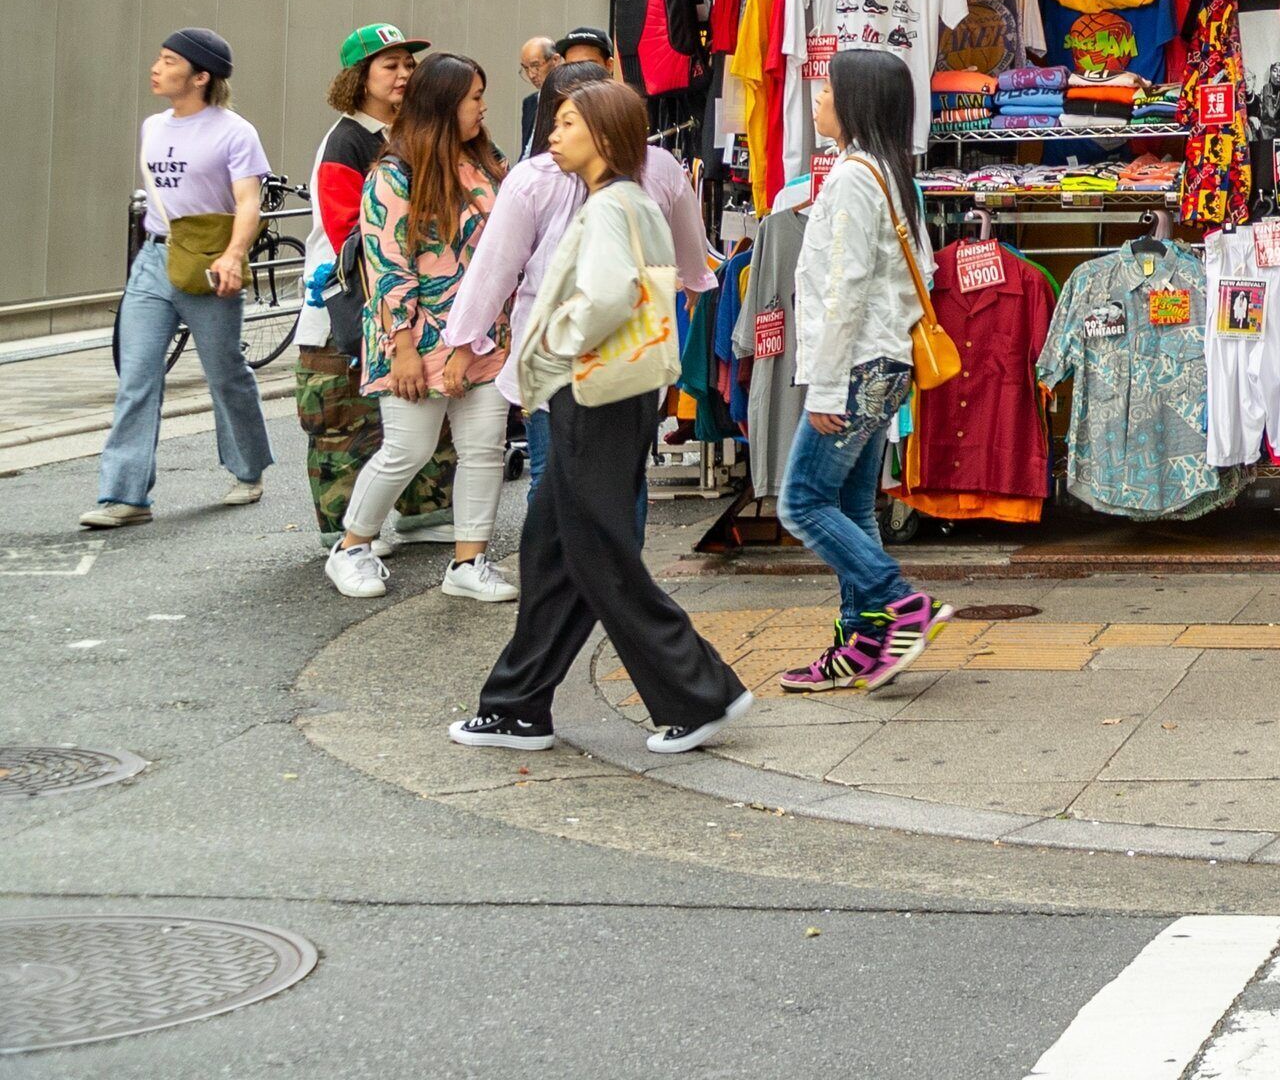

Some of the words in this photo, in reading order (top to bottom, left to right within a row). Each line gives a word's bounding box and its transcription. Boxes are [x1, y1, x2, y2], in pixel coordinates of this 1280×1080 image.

[1207, 93, 1225, 104] 本日
[1207, 103, 1225, 114] 入荷
[168, 147, 173, 157] I
[147, 161, 187, 173] MUST
[155, 176, 182, 188] SAY
[957, 242, 996, 258] FINISH!!
[963, 266, 999, 287] ¥1900
[1086, 325, 1125, 337] VINTAGE!
